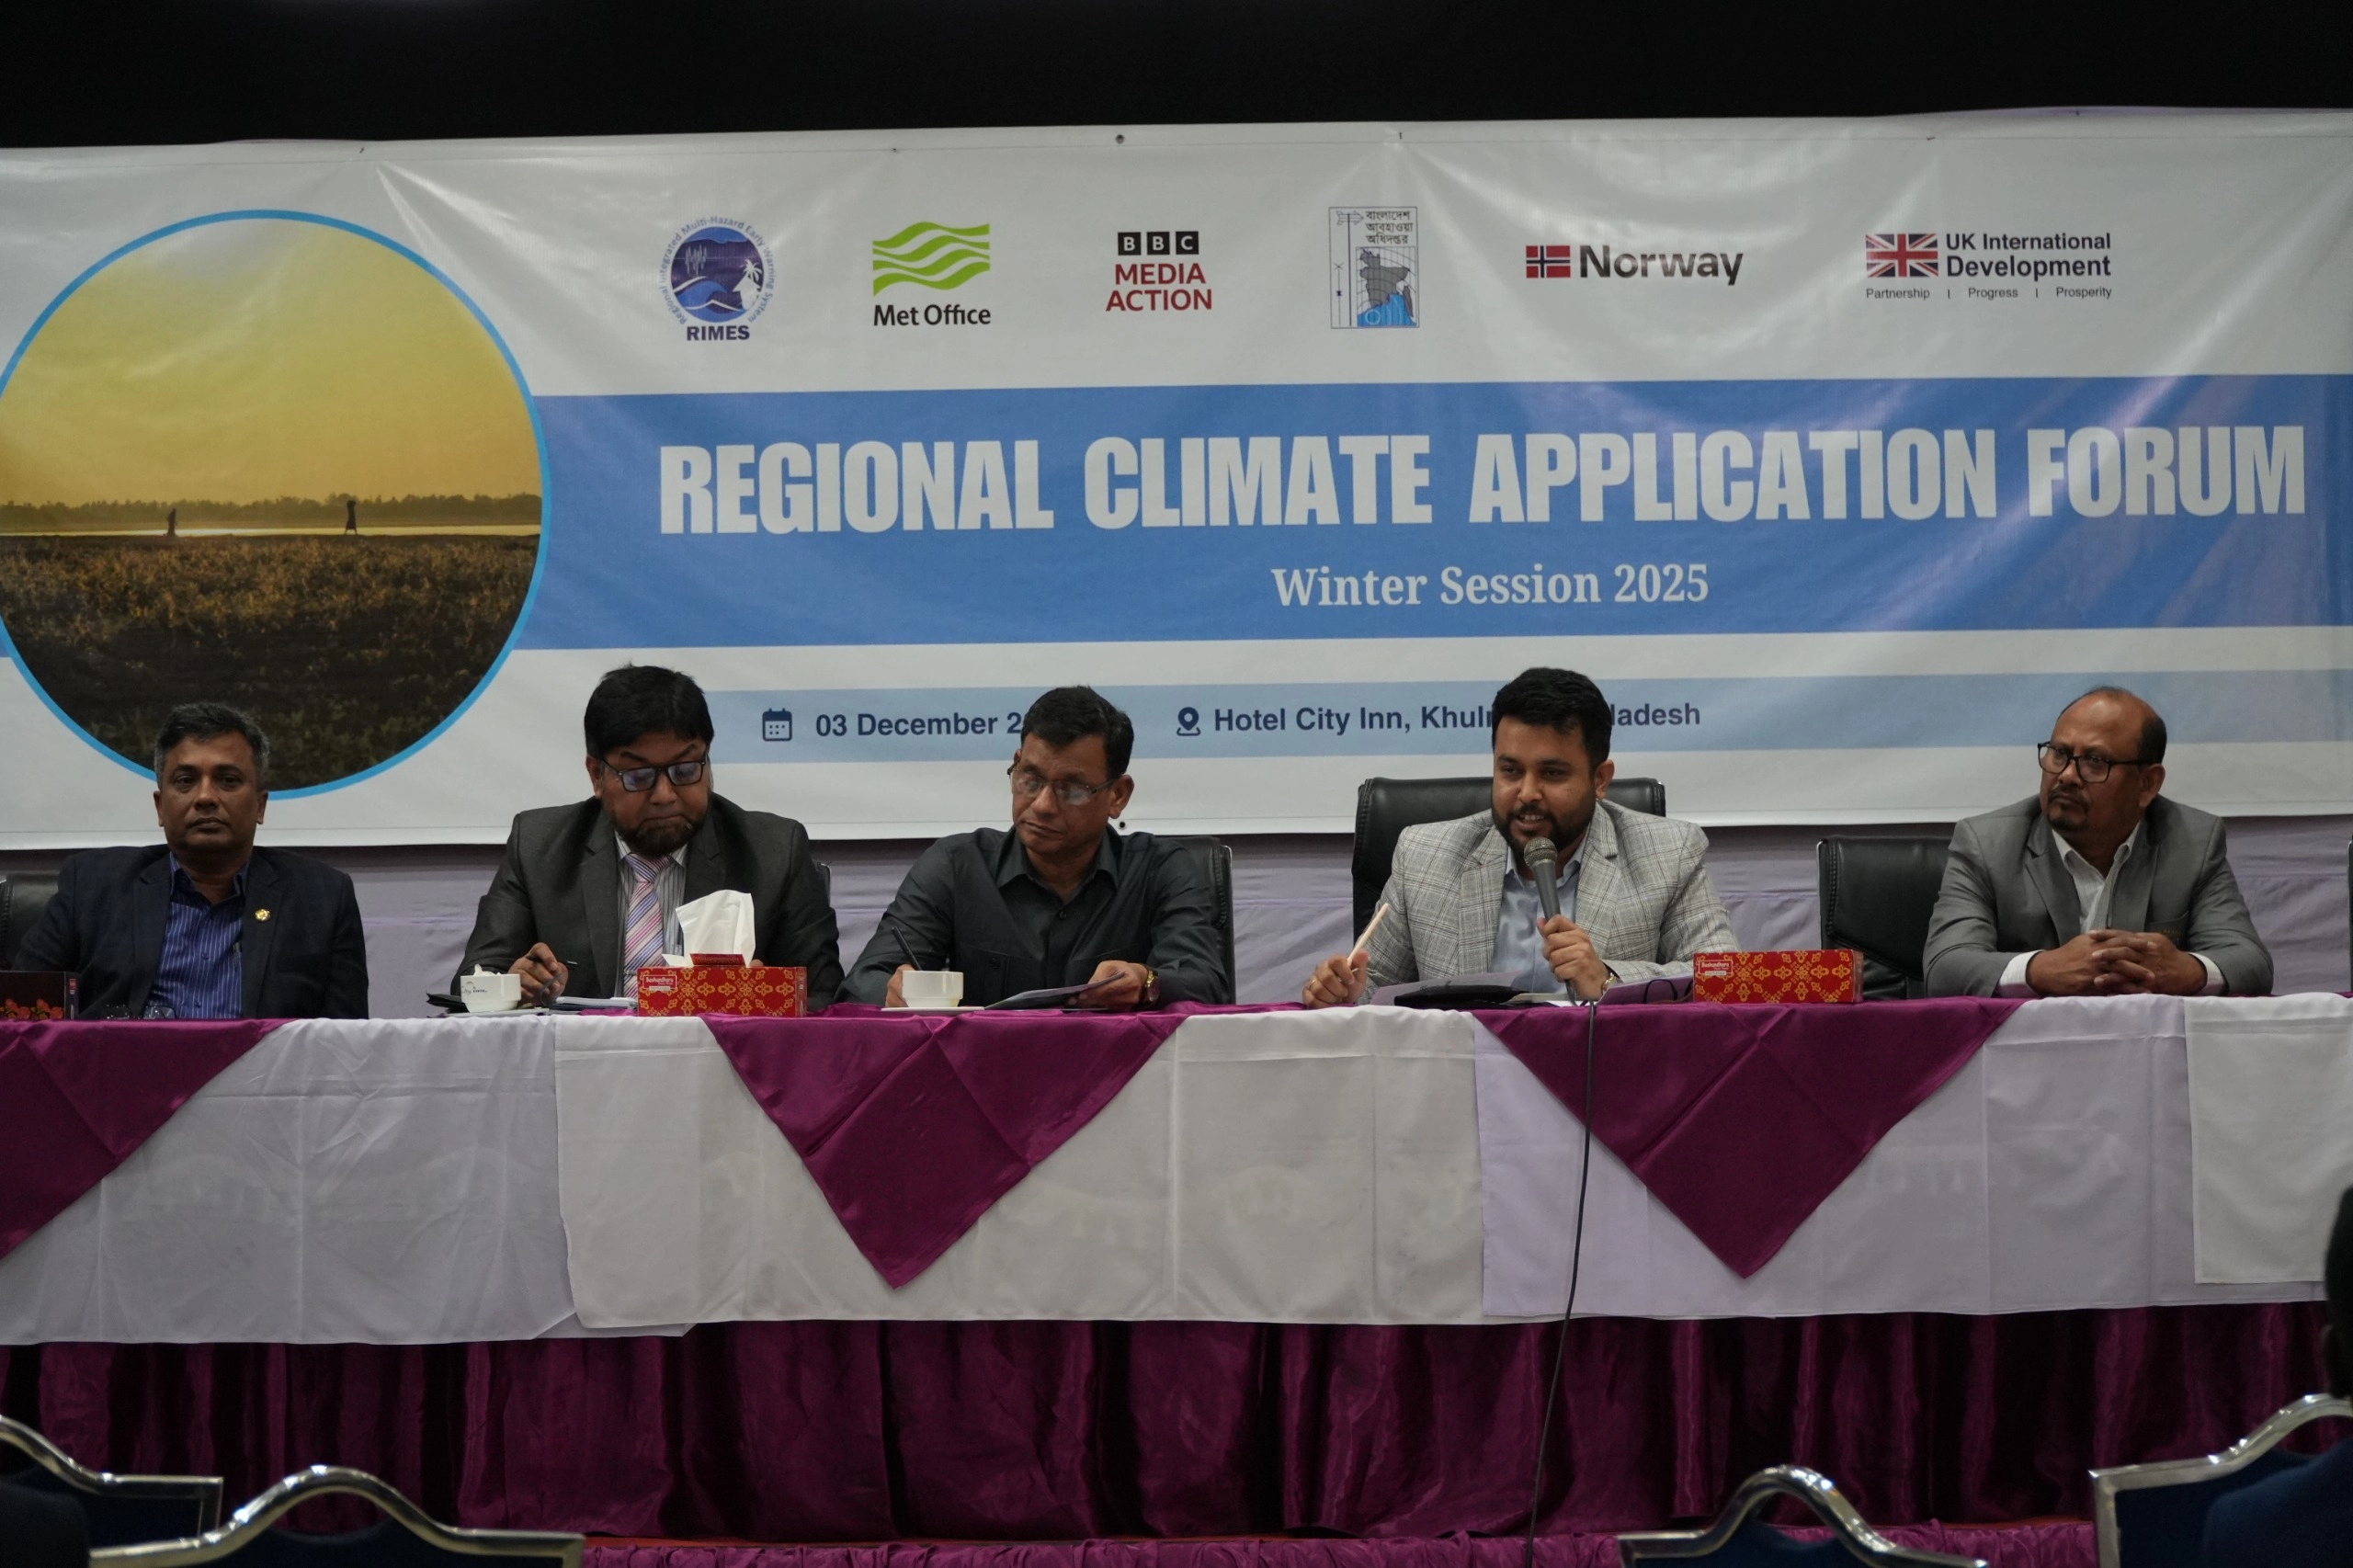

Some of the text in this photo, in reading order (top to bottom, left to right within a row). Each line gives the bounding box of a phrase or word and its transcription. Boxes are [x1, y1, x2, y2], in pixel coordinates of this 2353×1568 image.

[1365, 210, 1410, 221] বাংলাদেশ
[1365, 222, 1413, 232] আবহাওয়া
[745, 225, 765, 247] Early
[1121, 234, 1195, 253] BBC
[1365, 232, 1408, 244] অধিদপ্তর
[1946, 232, 2111, 250] UK International
[763, 246, 775, 290] Warning
[1115, 262, 1207, 286] MEDIA
[1579, 244, 1744, 286] Norway
[1947, 255, 2111, 282] Development
[1106, 289, 1212, 312] ACTION
[1866, 286, 2112, 301] Partnership Progress Prosperity
[747, 291, 773, 323] System
[873, 303, 992, 326] Met Office
[687, 324, 750, 341] RIMES
[660, 425, 2305, 534] REGIONAL CLIMATE APPLICATION FORUM
[1270, 563, 1709, 607] Winter Session 2025
[815, 713, 847, 737] 03
[858, 711, 998, 736] December
[1214, 702, 1700, 735] Hotel City Inn, Khul ladesh
